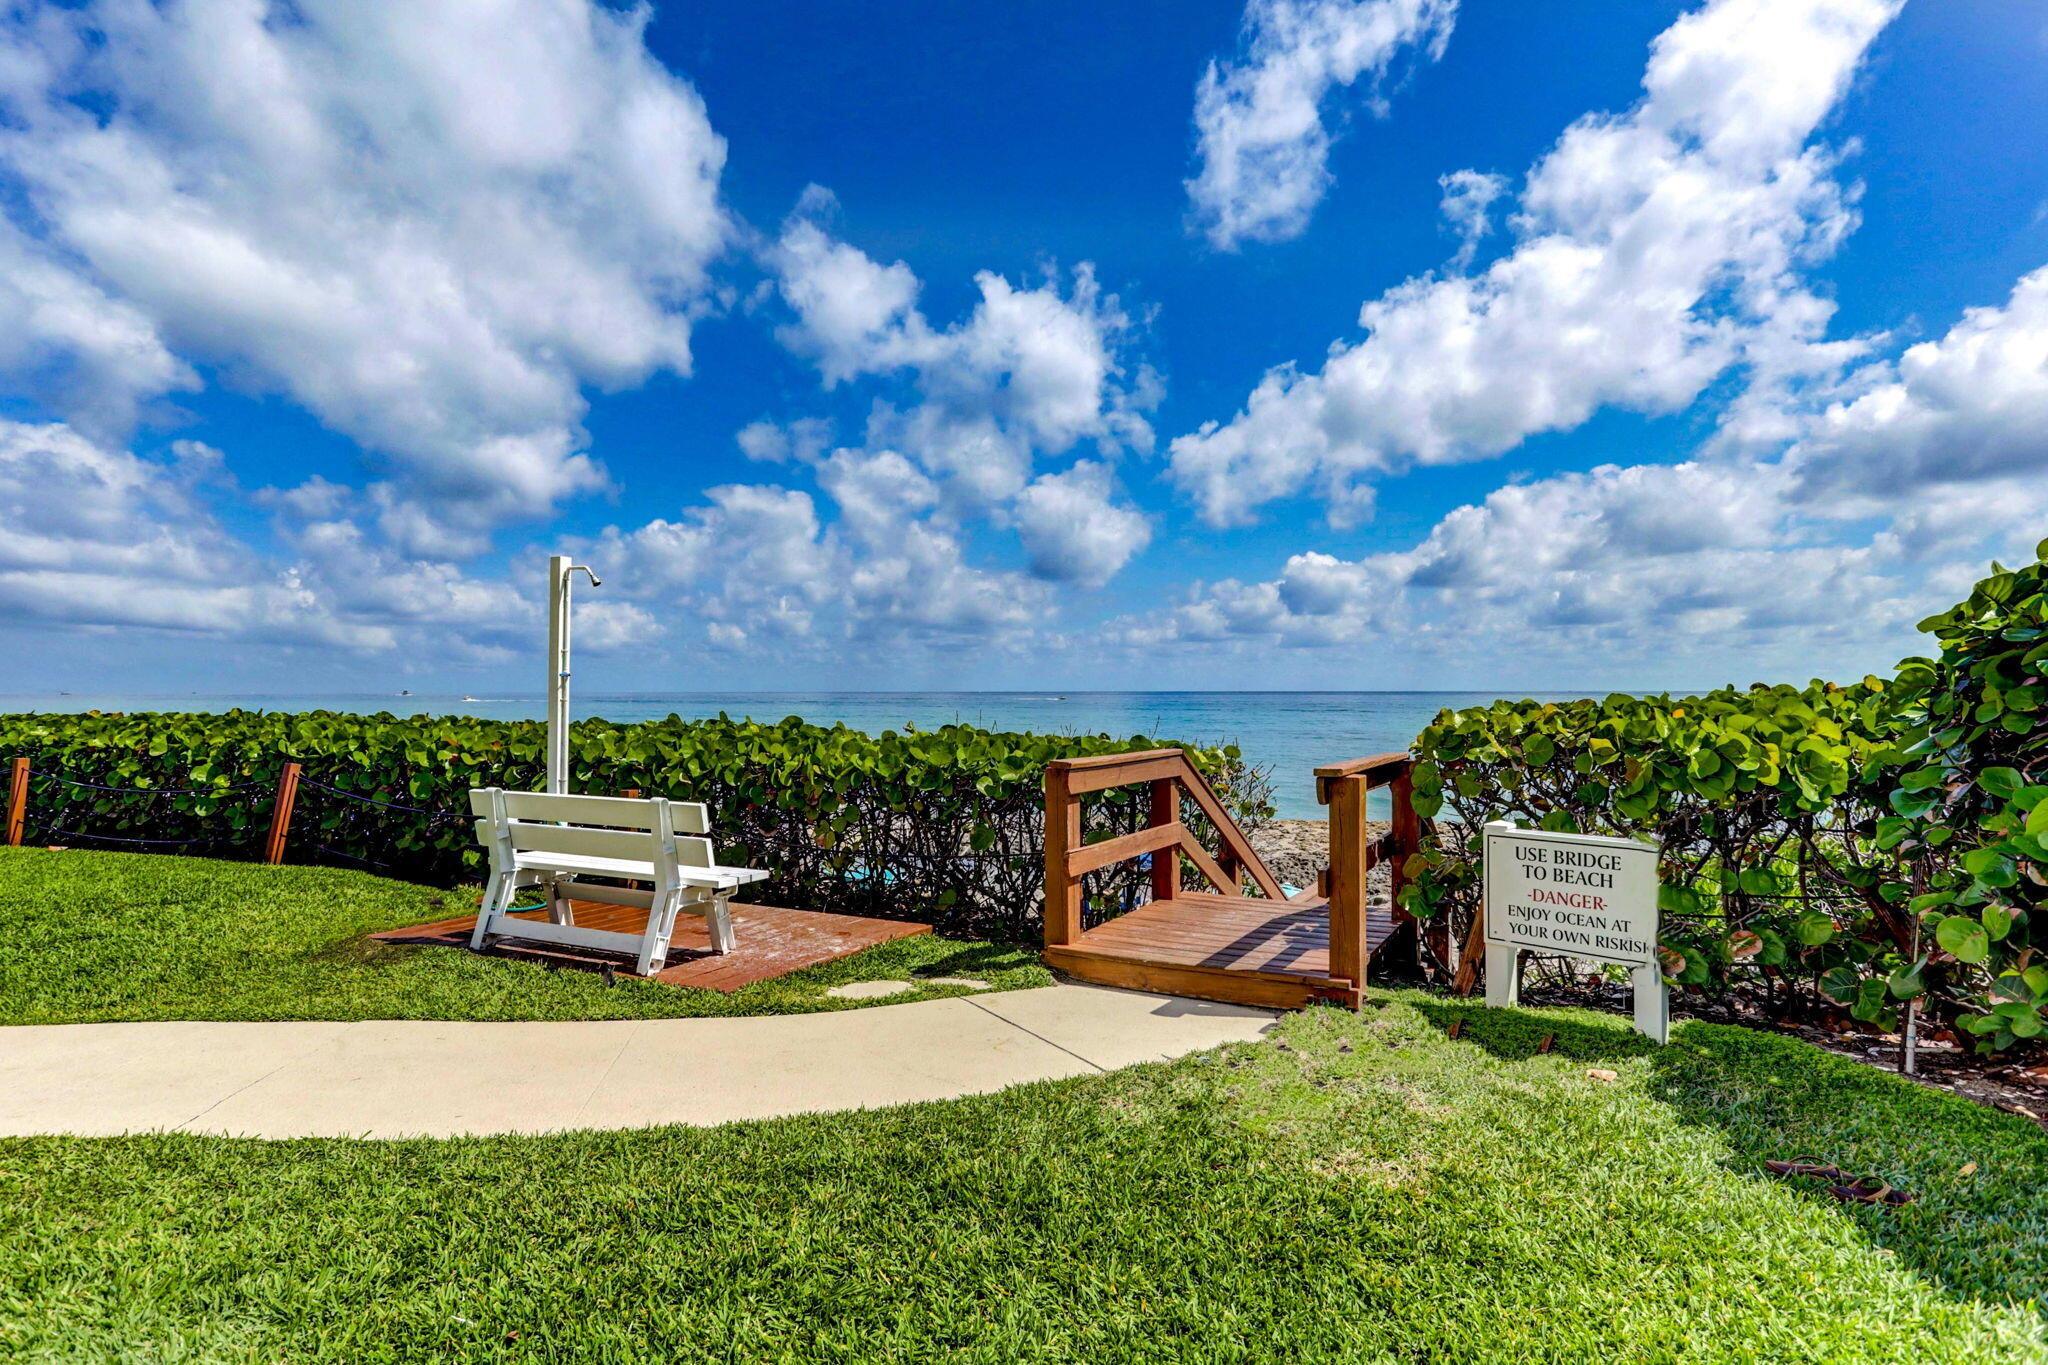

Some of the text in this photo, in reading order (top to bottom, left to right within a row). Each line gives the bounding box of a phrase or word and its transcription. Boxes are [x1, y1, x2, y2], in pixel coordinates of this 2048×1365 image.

[1516, 846, 1621, 871] USE BRIDGE
[1522, 864, 1613, 888] TO BEACH
[1527, 888, 1608, 911] -DANGER-
[1508, 904, 1631, 932] ENJOY OCEAN AT
[1509, 922, 1548, 939] YOUR
[1553, 929, 1590, 945] OWN
